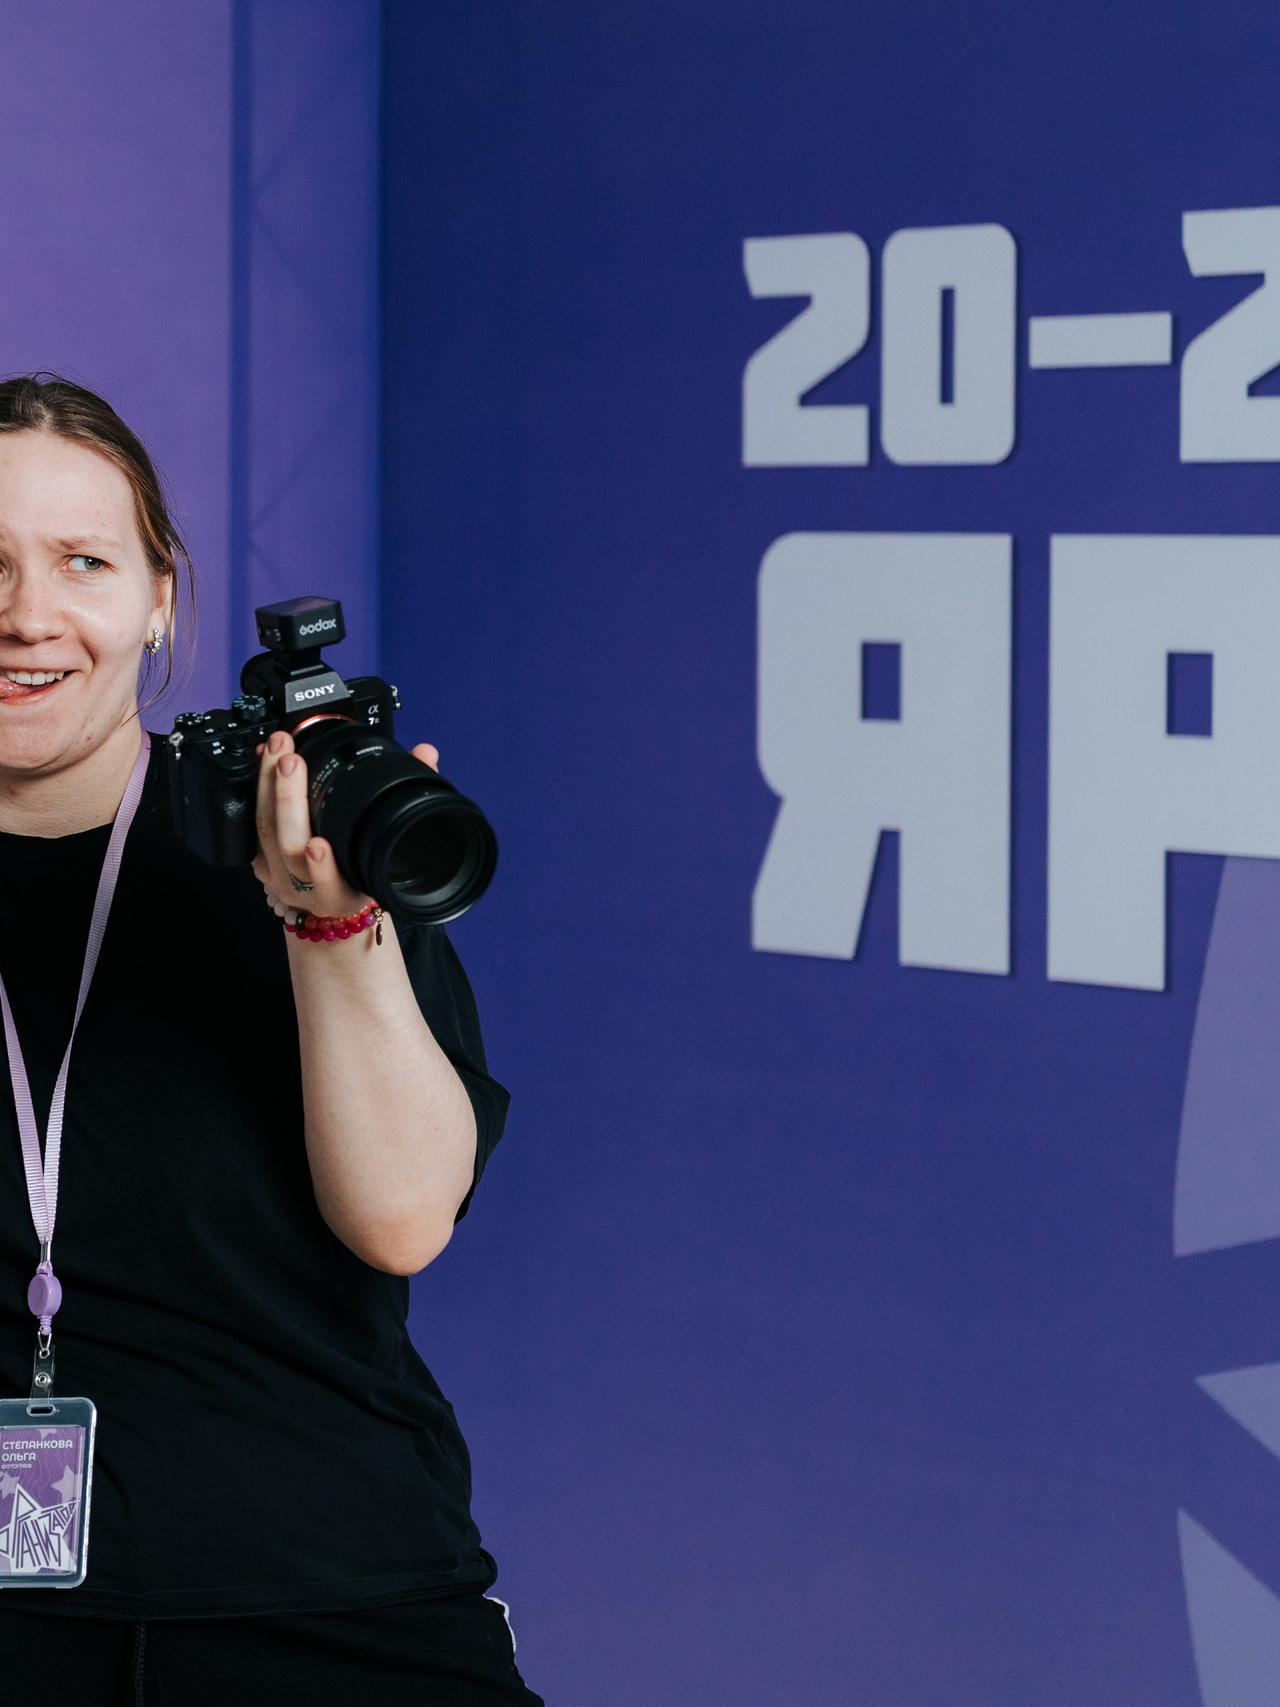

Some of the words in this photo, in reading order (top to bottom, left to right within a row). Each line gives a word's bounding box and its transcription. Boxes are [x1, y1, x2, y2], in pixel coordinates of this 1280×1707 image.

[299, 618, 338, 636] Godox
[294, 683, 336, 702] SONY
[752, 531, 1280, 992] ЯР
[2, 1439, 74, 1451] СТЕПАНКОВА
[1, 1452, 37, 1462] ОЛЬГА
